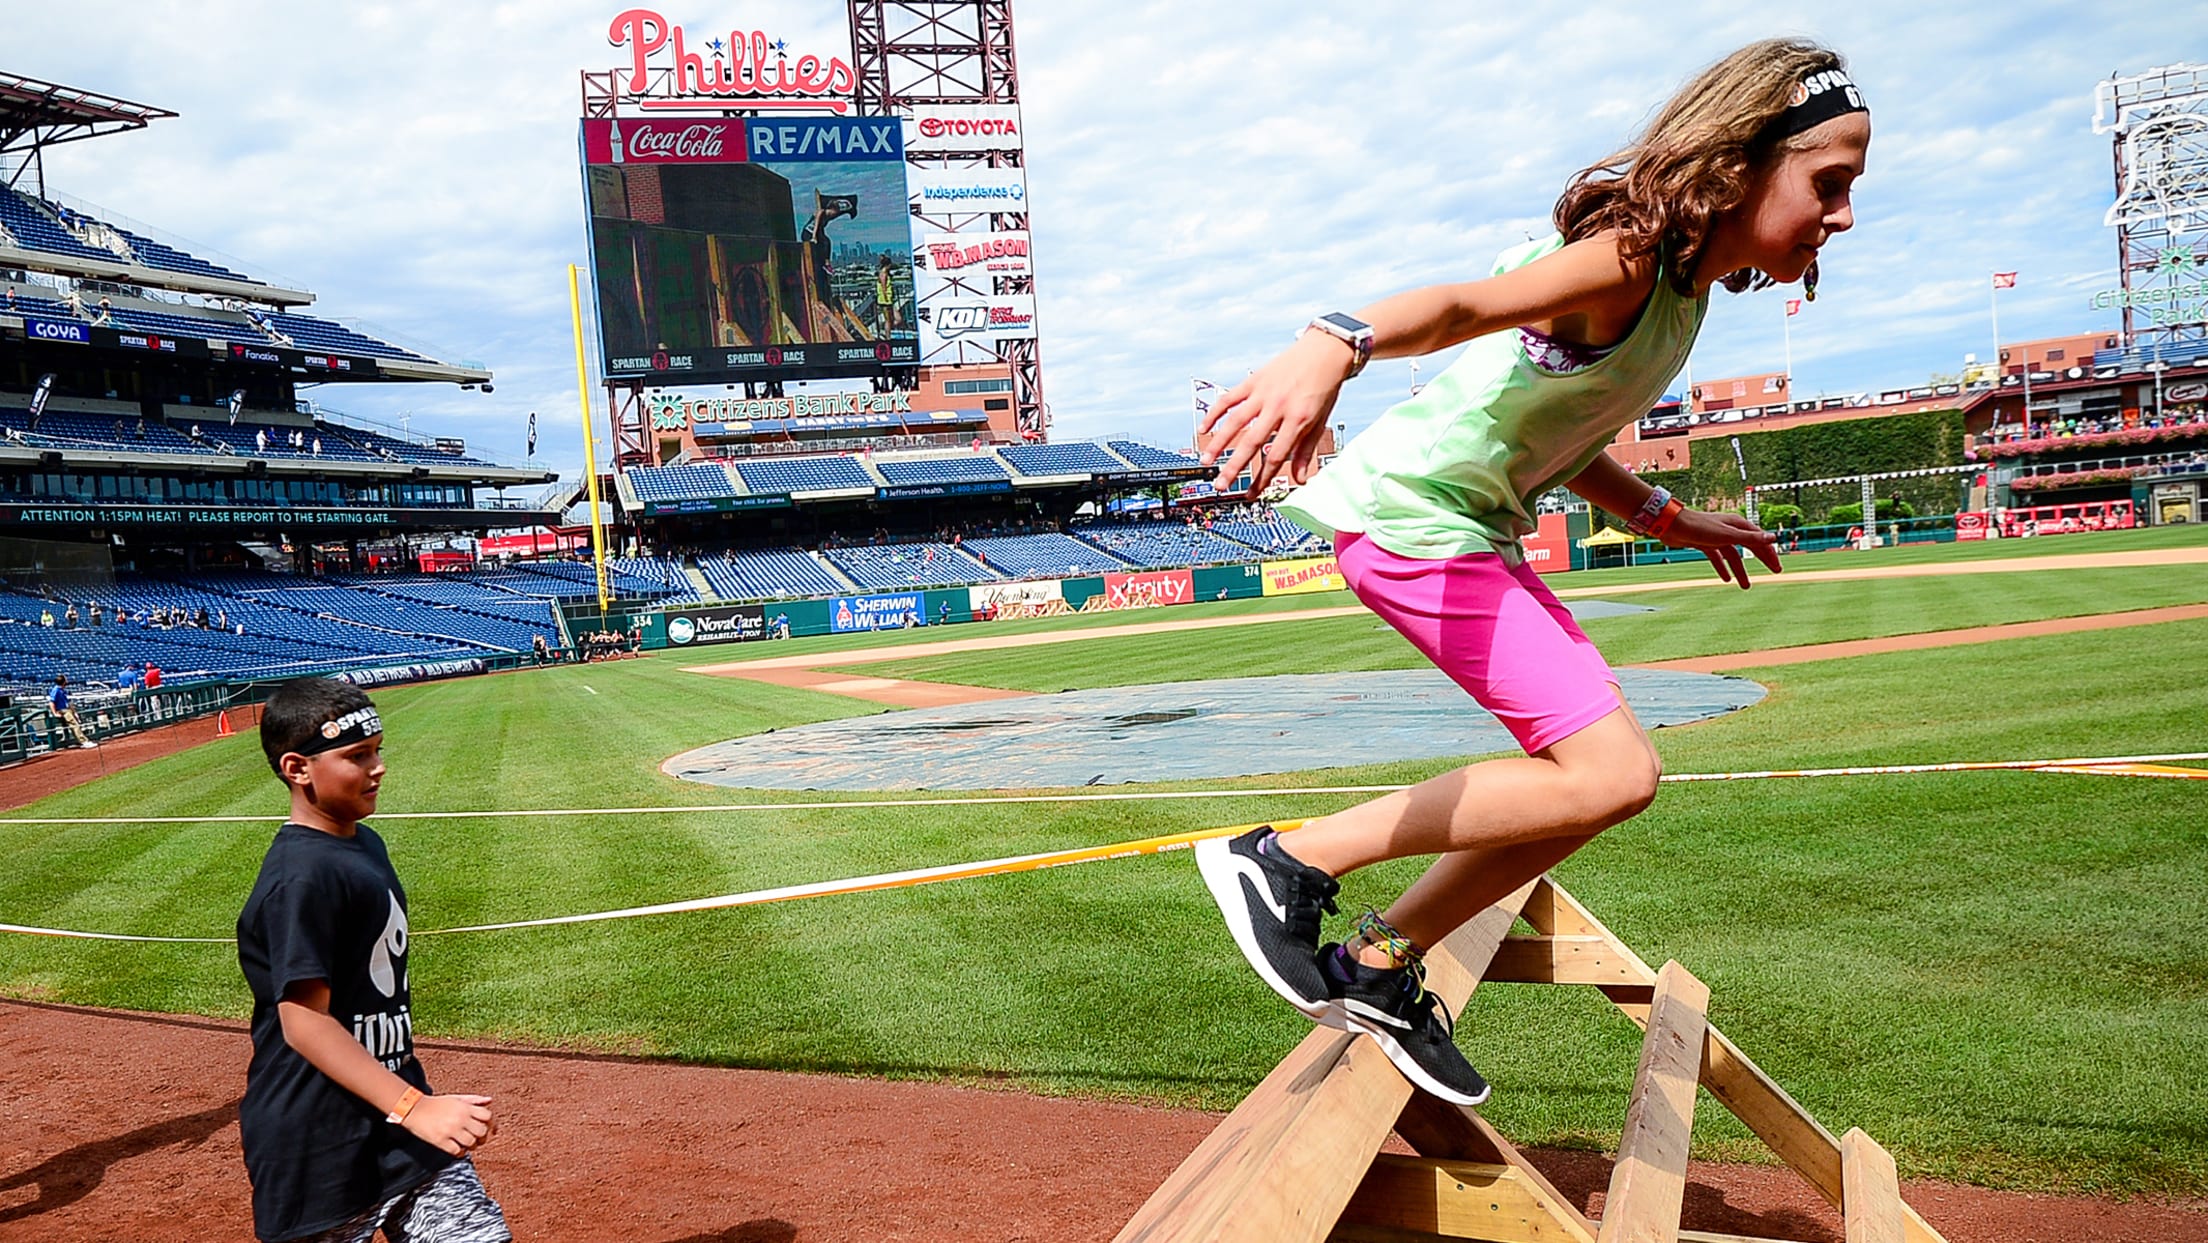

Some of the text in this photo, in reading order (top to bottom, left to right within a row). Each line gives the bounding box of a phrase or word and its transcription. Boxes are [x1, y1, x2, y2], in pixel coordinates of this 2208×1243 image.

[608, 8, 855, 94] Phillies
[944, 119, 1017, 135] TOYOTA
[630, 125, 727, 157] Coca-Cola
[752, 126, 894, 154] RE/MAX
[924, 184, 1008, 201] Independence
[2095, 286, 2193, 309] Citizens
[938, 307, 987, 329] KDI
[2152, 303, 2205, 325] Park
[35, 323, 80, 339] GOYA
[245, 350, 279, 362] Fanatics
[727, 351, 805, 364] SPARTAN RACE
[838, 346, 913, 359] SPARTAN RACE
[612, 356, 693, 369] SPARTAN RACE
[691, 389, 910, 422] Citizens Bank Park
[888, 488, 920, 497] Jefferson
[21, 510, 397, 523] ATTENTION 1:15PM HEAT! PLEASE REPORT TO THE STARTING GATE...
[1244, 566, 1259, 577] 374
[854, 596, 917, 612] SHERWIN
[633, 615, 653, 627] 334
[696, 614, 763, 633] NovaCare
[351, 659, 474, 685] MLB NETWORK MLB NETWORK
